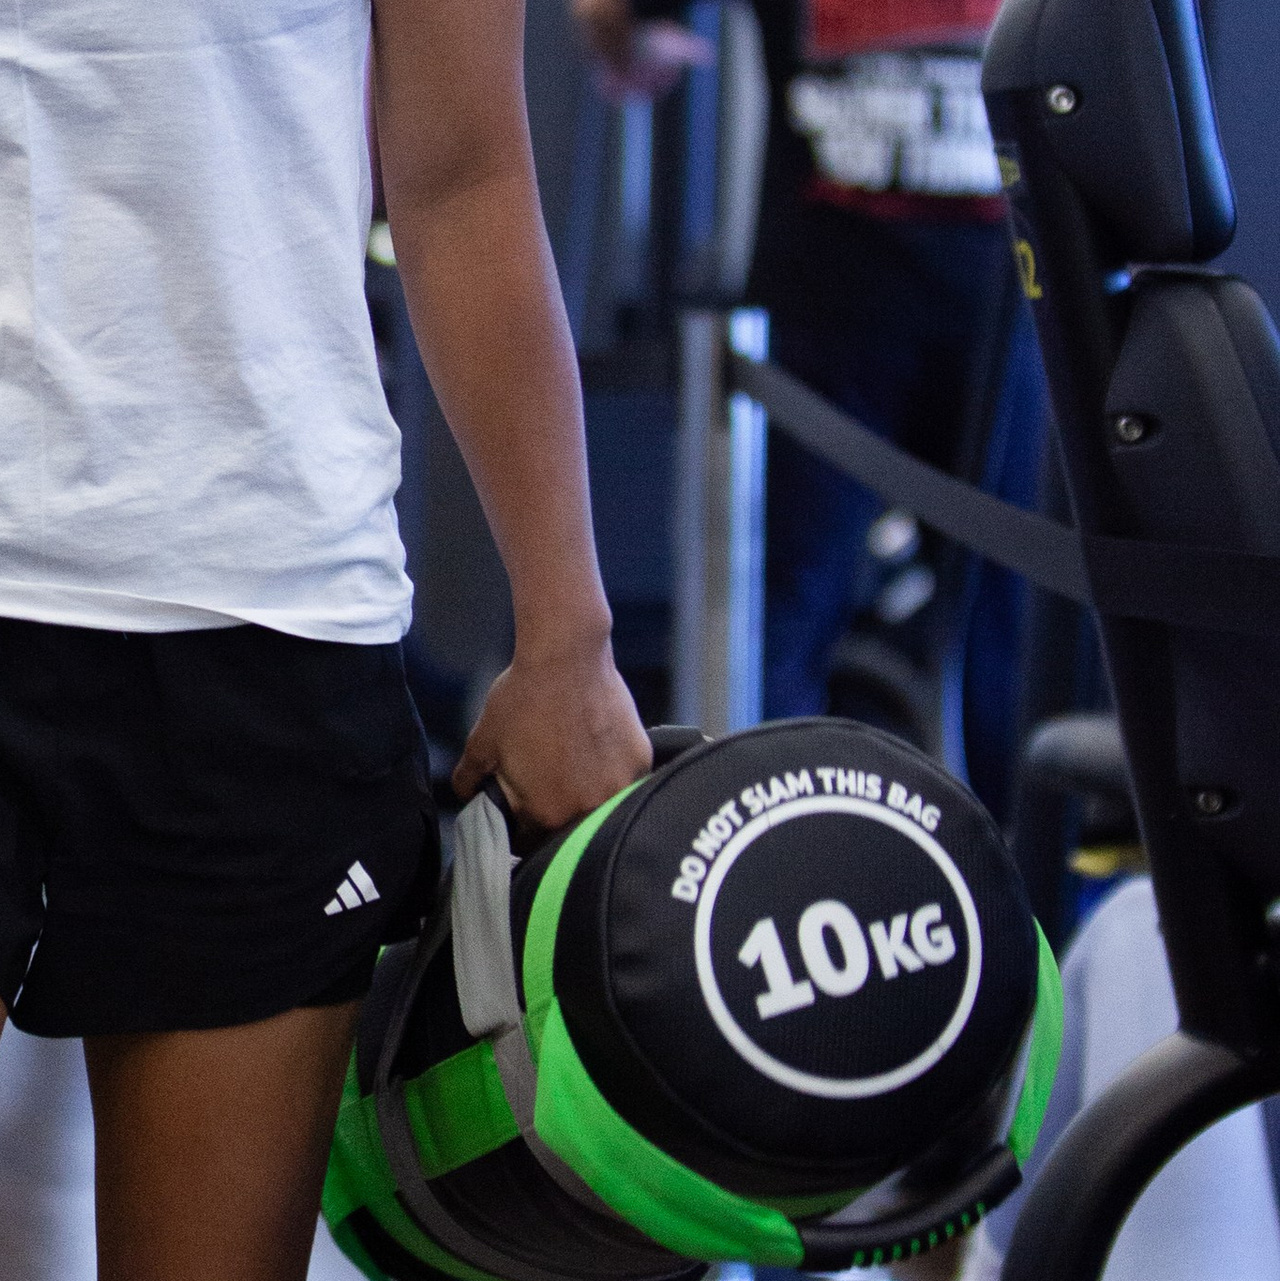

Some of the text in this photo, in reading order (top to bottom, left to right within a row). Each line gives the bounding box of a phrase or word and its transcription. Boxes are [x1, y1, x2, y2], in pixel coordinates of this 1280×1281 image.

[672, 767, 941, 904] DO NOT SLAM THIS BAG
